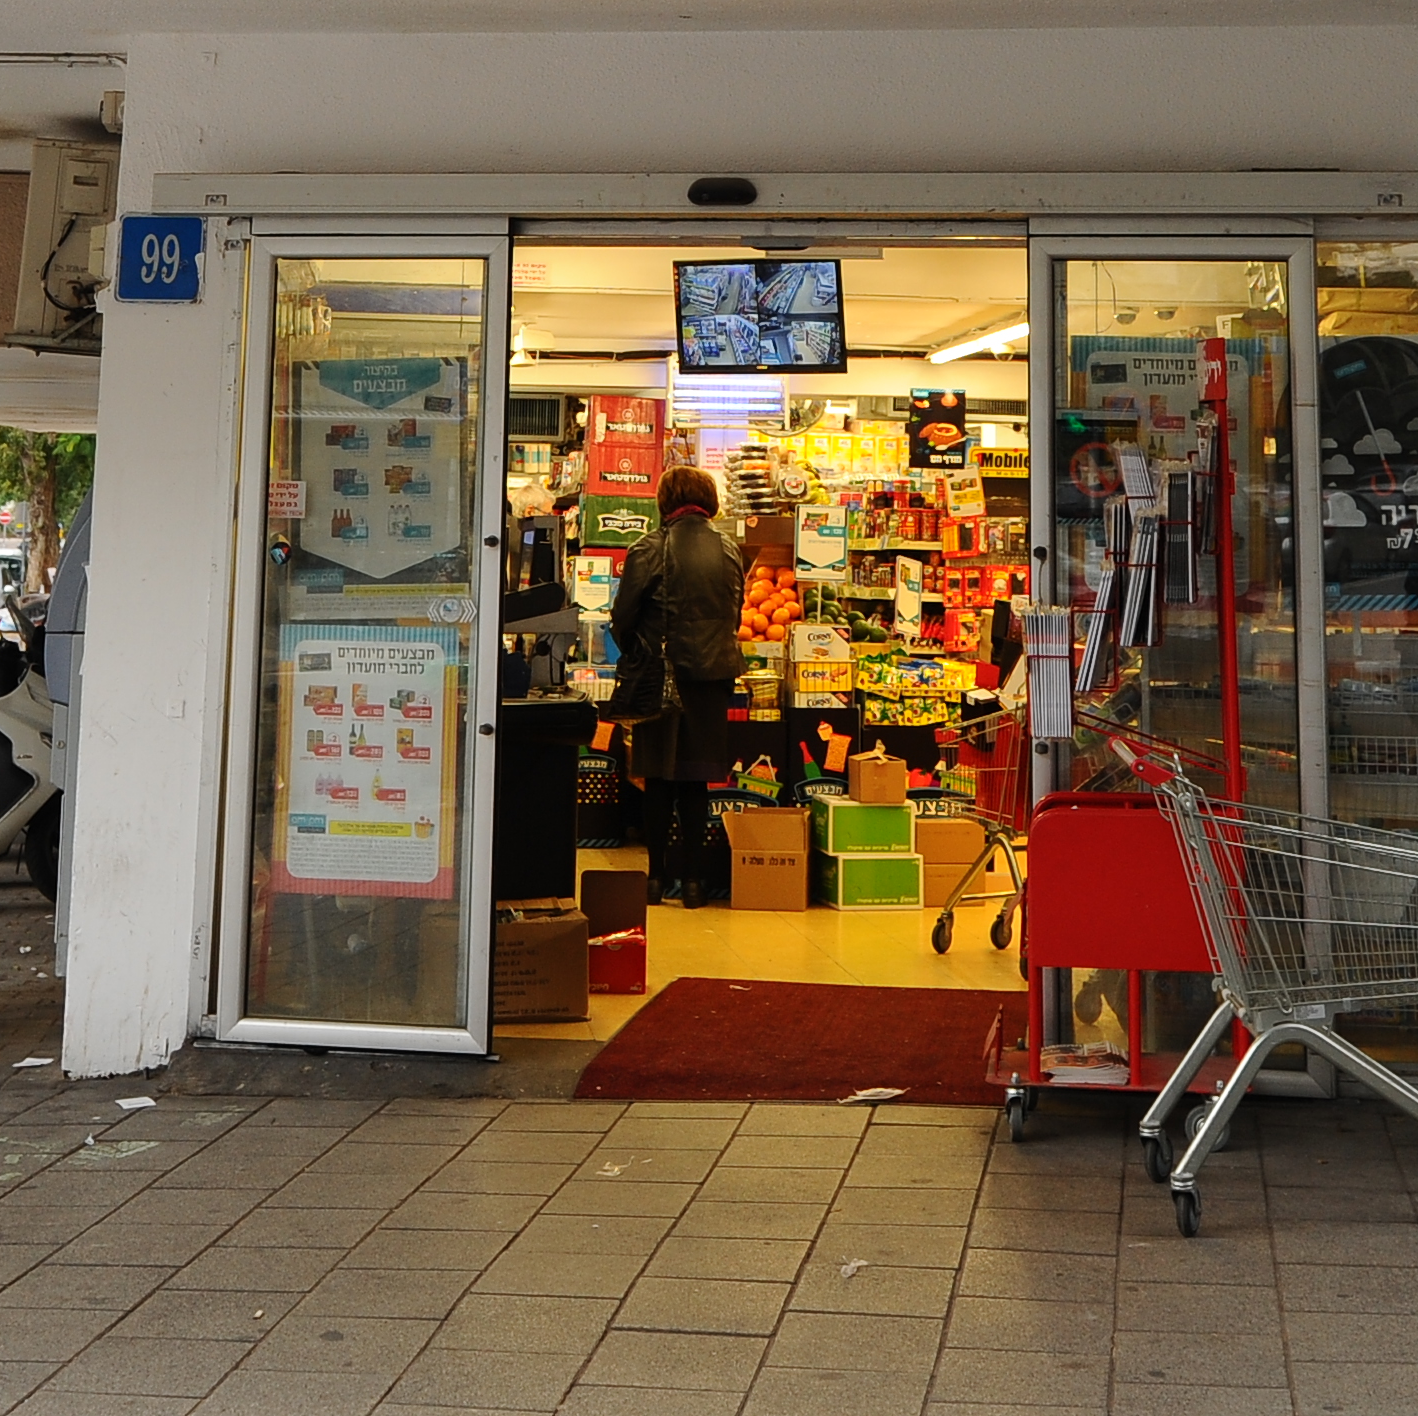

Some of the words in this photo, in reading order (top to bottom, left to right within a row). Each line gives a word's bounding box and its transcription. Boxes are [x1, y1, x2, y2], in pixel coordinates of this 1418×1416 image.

[141, 233, 180, 284] 99
[1133, 357, 1184, 371] מיוחדים
[352, 378, 407, 393] מבצעים
[1143, 371, 1186, 386] מועדון
[337, 646, 385, 660] מיוחדים
[388, 648, 435, 661] מבצעים
[346, 662, 385, 675] מועדון
[389, 660, 425, 675] לחברי
